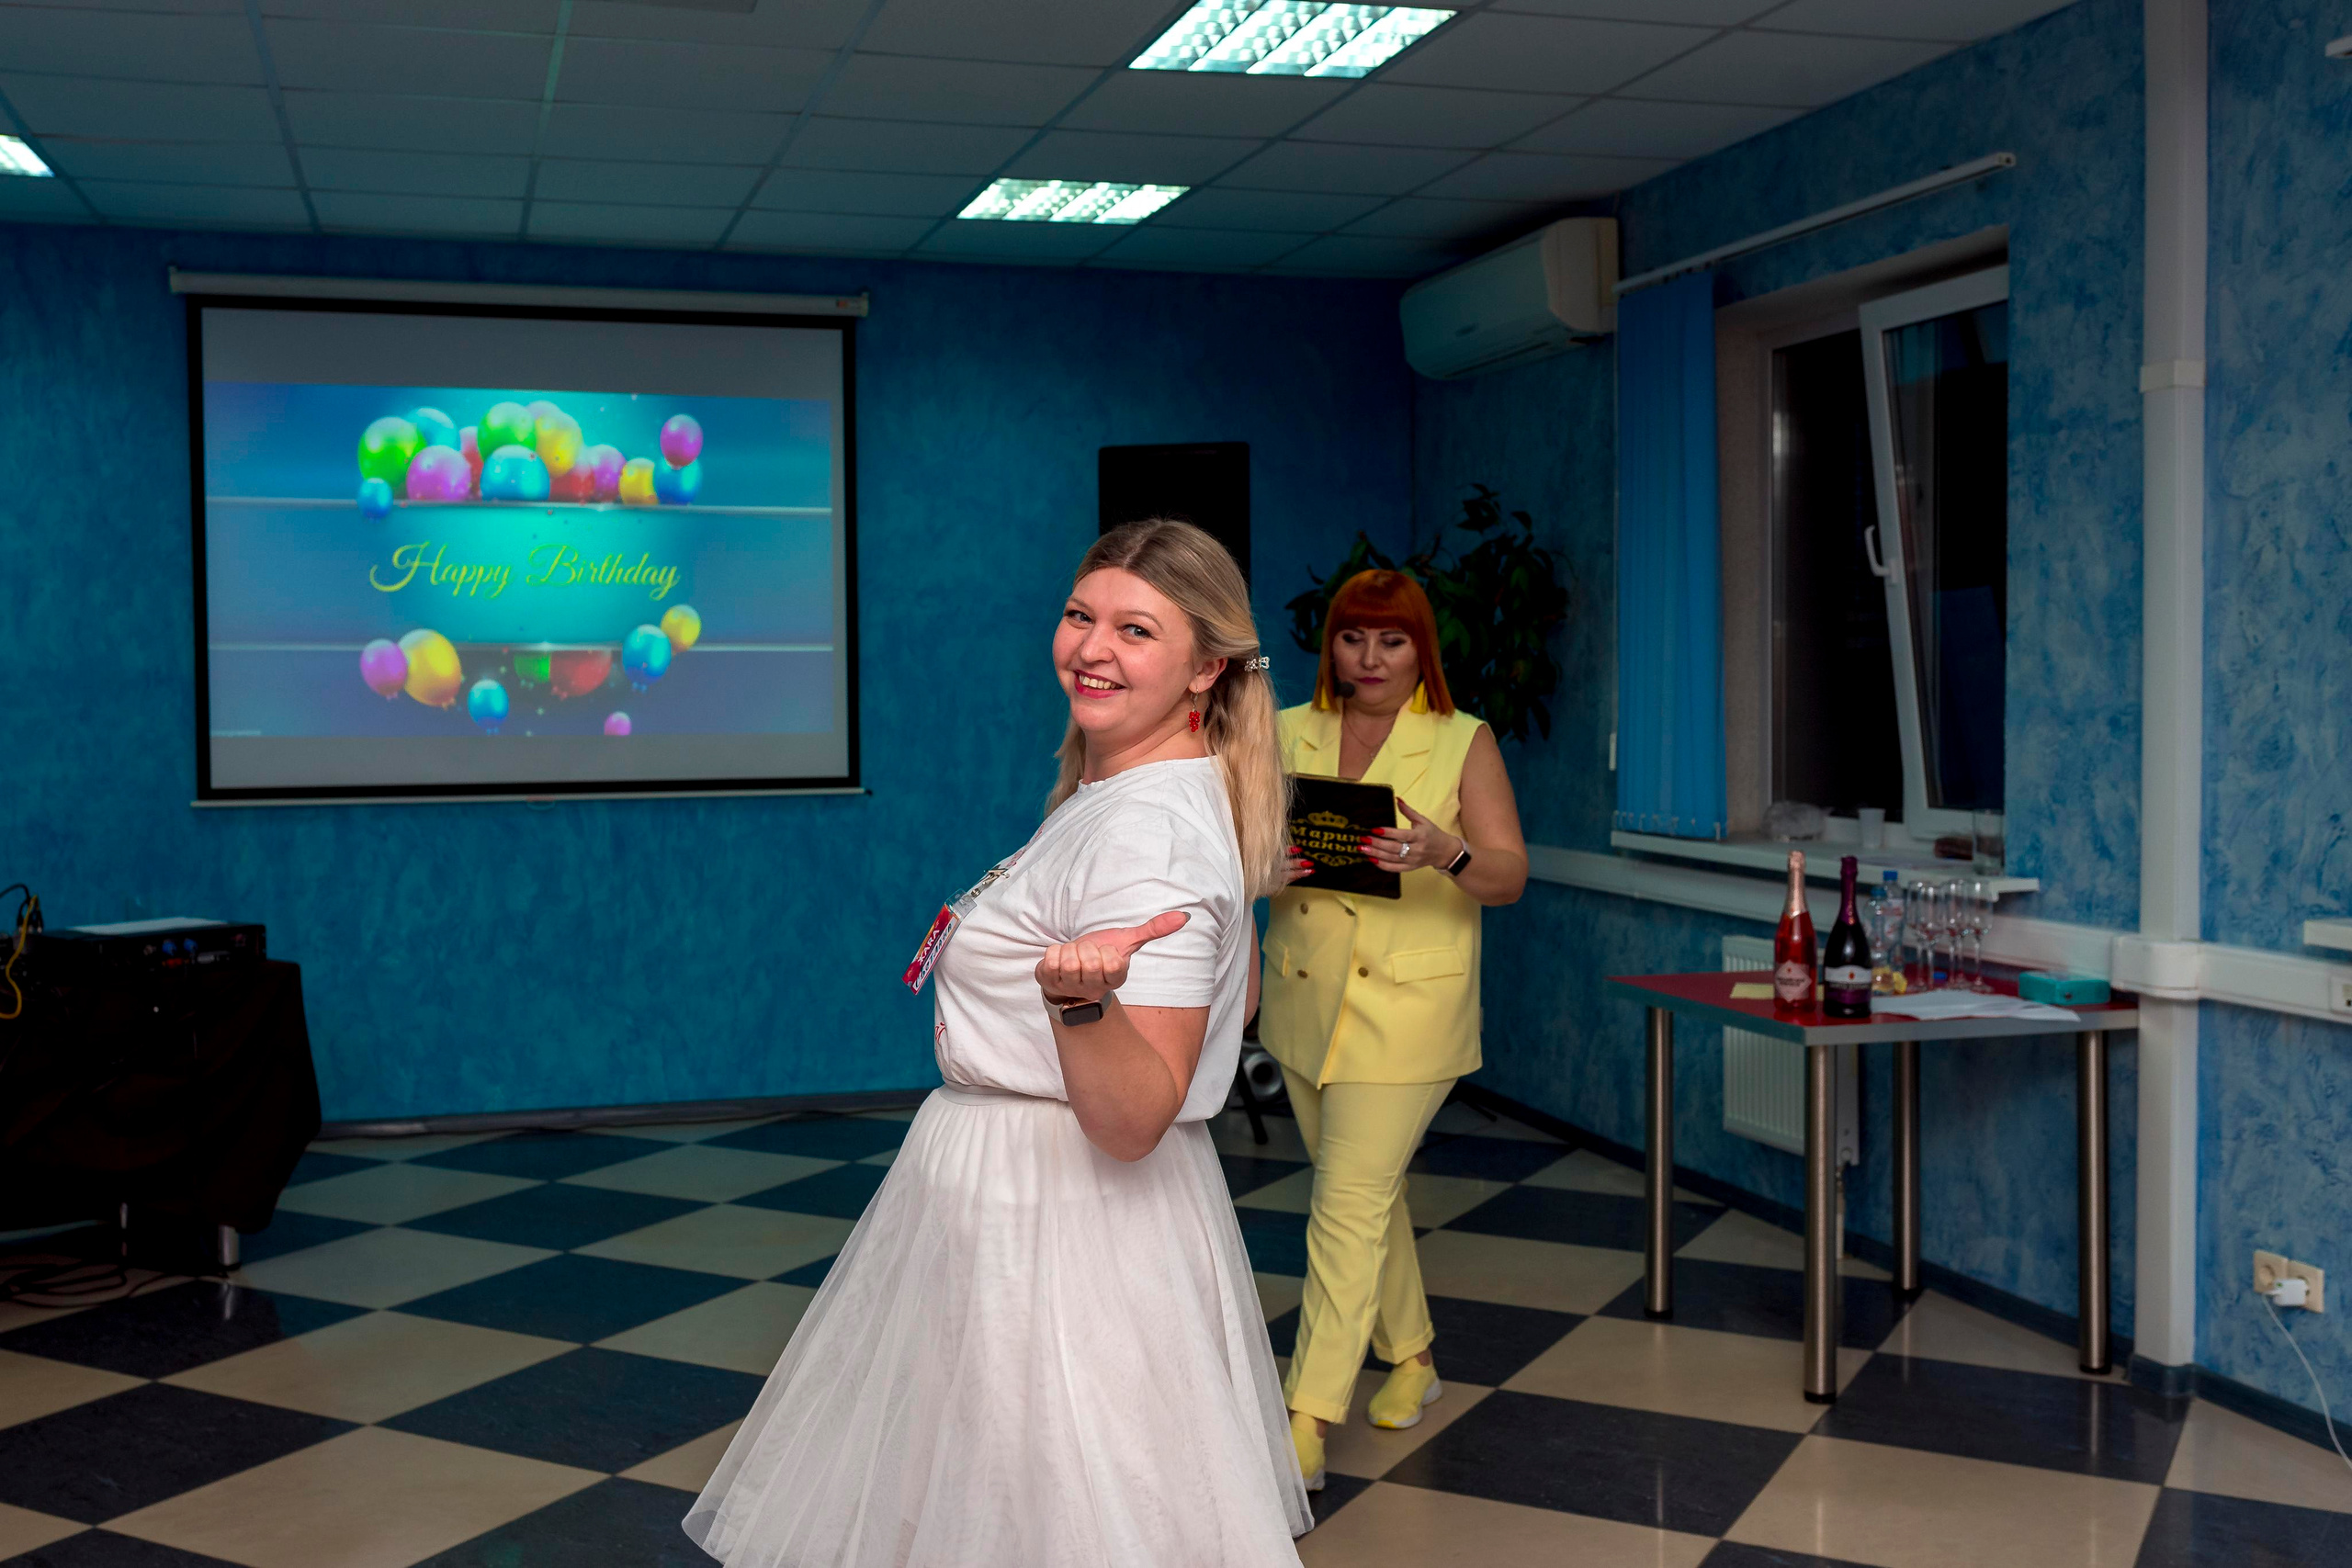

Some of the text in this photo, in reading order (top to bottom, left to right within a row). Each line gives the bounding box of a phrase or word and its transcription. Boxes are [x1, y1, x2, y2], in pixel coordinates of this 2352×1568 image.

[369, 540, 681, 601] Happy Birthday
[1290, 827, 1361, 843] Марин
